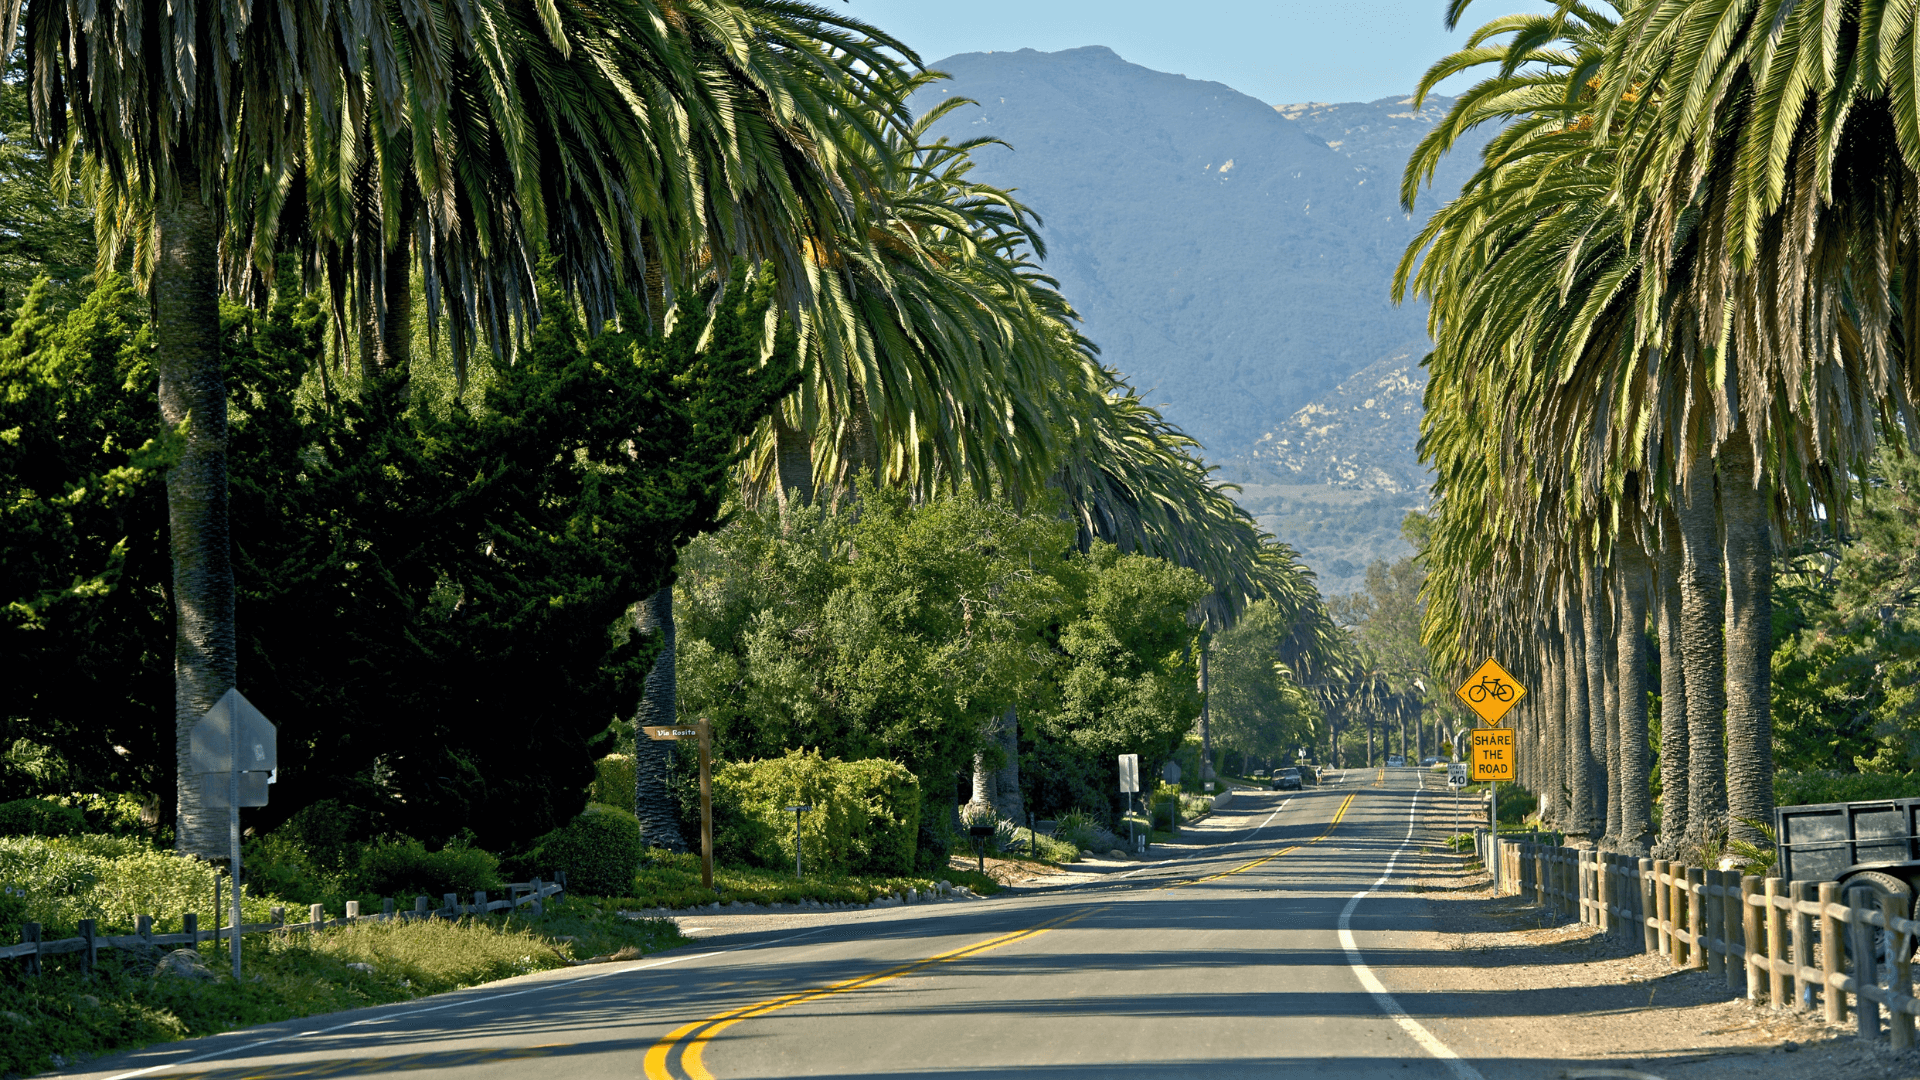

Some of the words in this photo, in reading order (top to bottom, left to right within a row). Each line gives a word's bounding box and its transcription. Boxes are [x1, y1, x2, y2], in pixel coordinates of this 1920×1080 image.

[657, 729, 670, 737] Via
[1474, 735, 1511, 746] SHARE
[1482, 749, 1503, 760] THE
[1478, 763, 1508, 774] ROAD
[1449, 775, 1465, 785] 40
